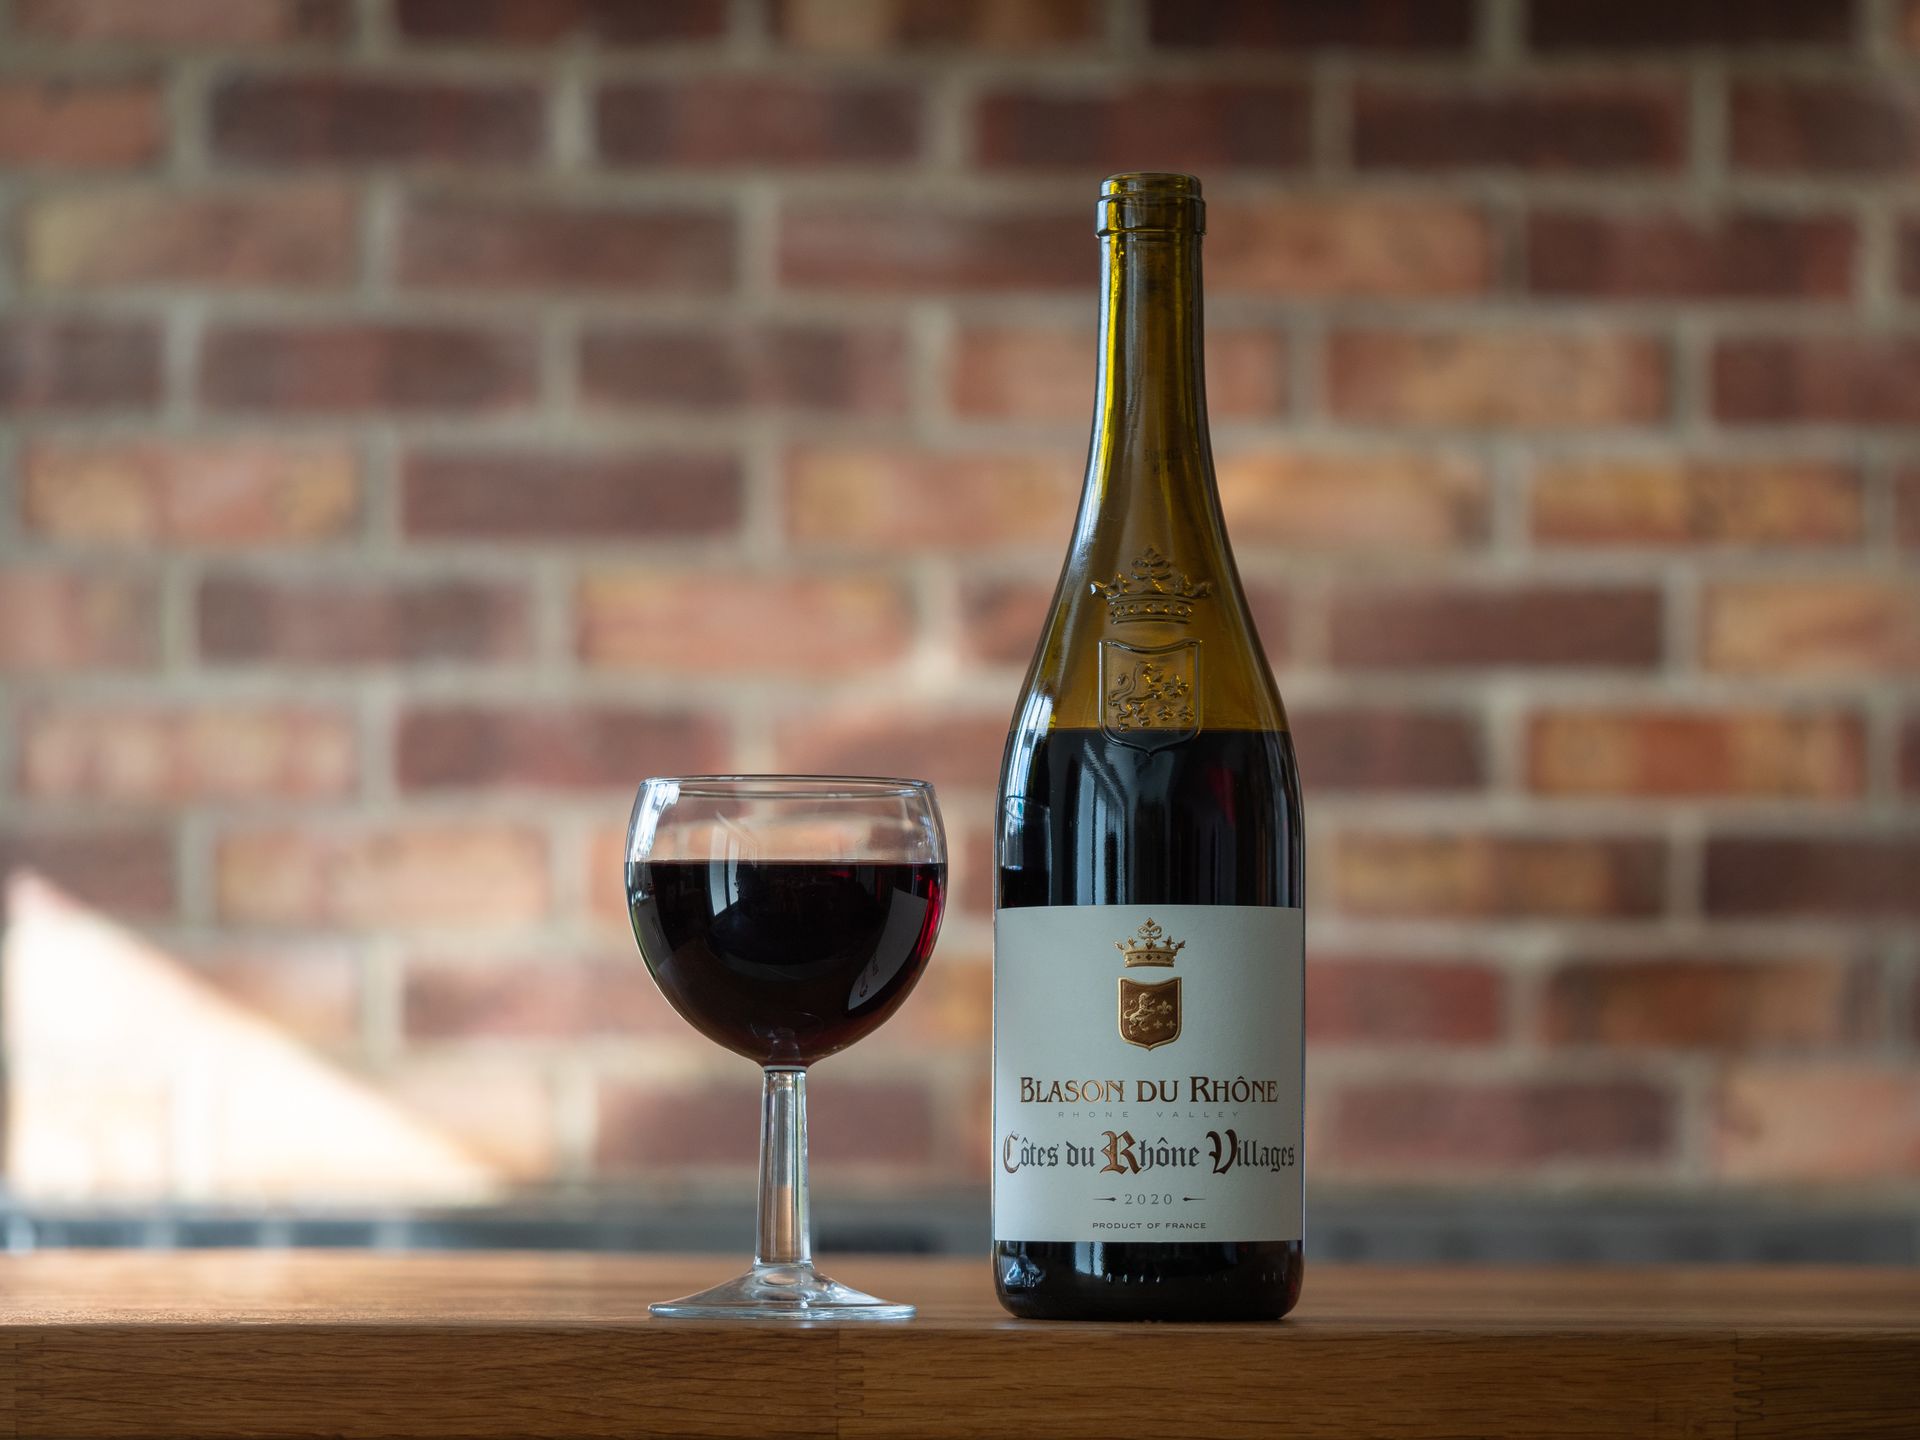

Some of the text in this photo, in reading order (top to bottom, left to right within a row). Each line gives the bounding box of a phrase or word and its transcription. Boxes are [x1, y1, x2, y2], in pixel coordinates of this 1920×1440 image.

[1020, 1075, 1278, 1103] BLASON DU RHÔNE
[1002, 1129, 1295, 1175] Côtes du Rhône Villages
[1124, 1193, 1173, 1206] 2020
